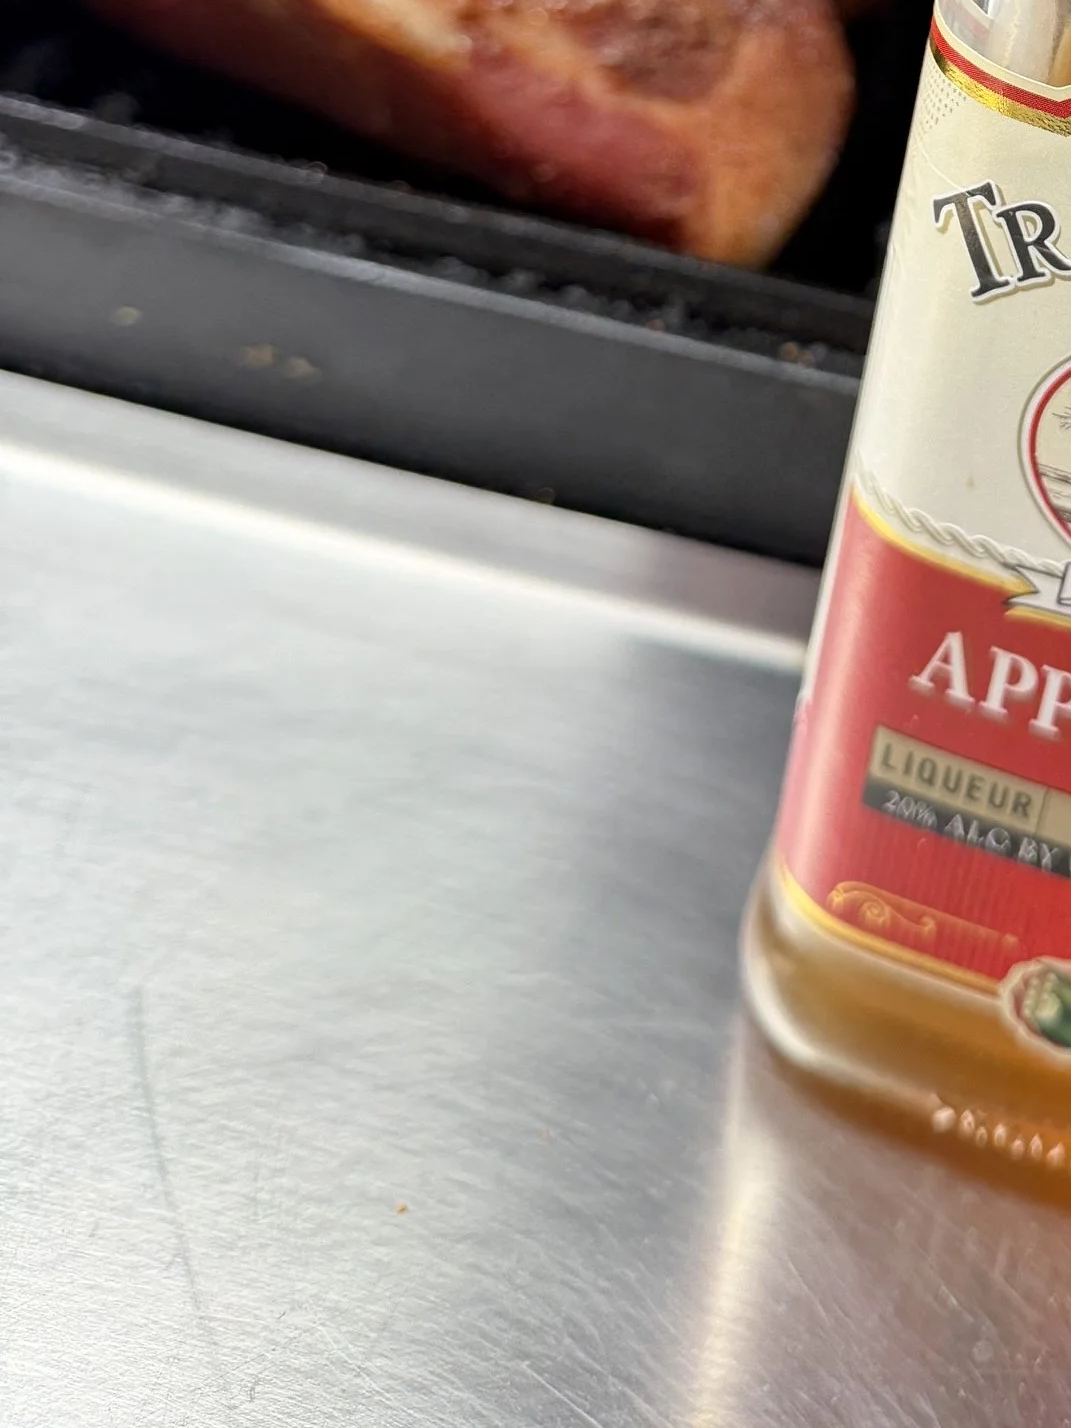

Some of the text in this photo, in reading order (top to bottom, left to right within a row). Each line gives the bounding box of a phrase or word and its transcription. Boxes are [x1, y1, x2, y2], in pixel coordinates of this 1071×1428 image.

[880, 742, 1033, 819] LIQUEUR
[882, 789, 938, 829] 20%
[944, 813, 1012, 855] ALC
[1018, 836, 1060, 871] BY
